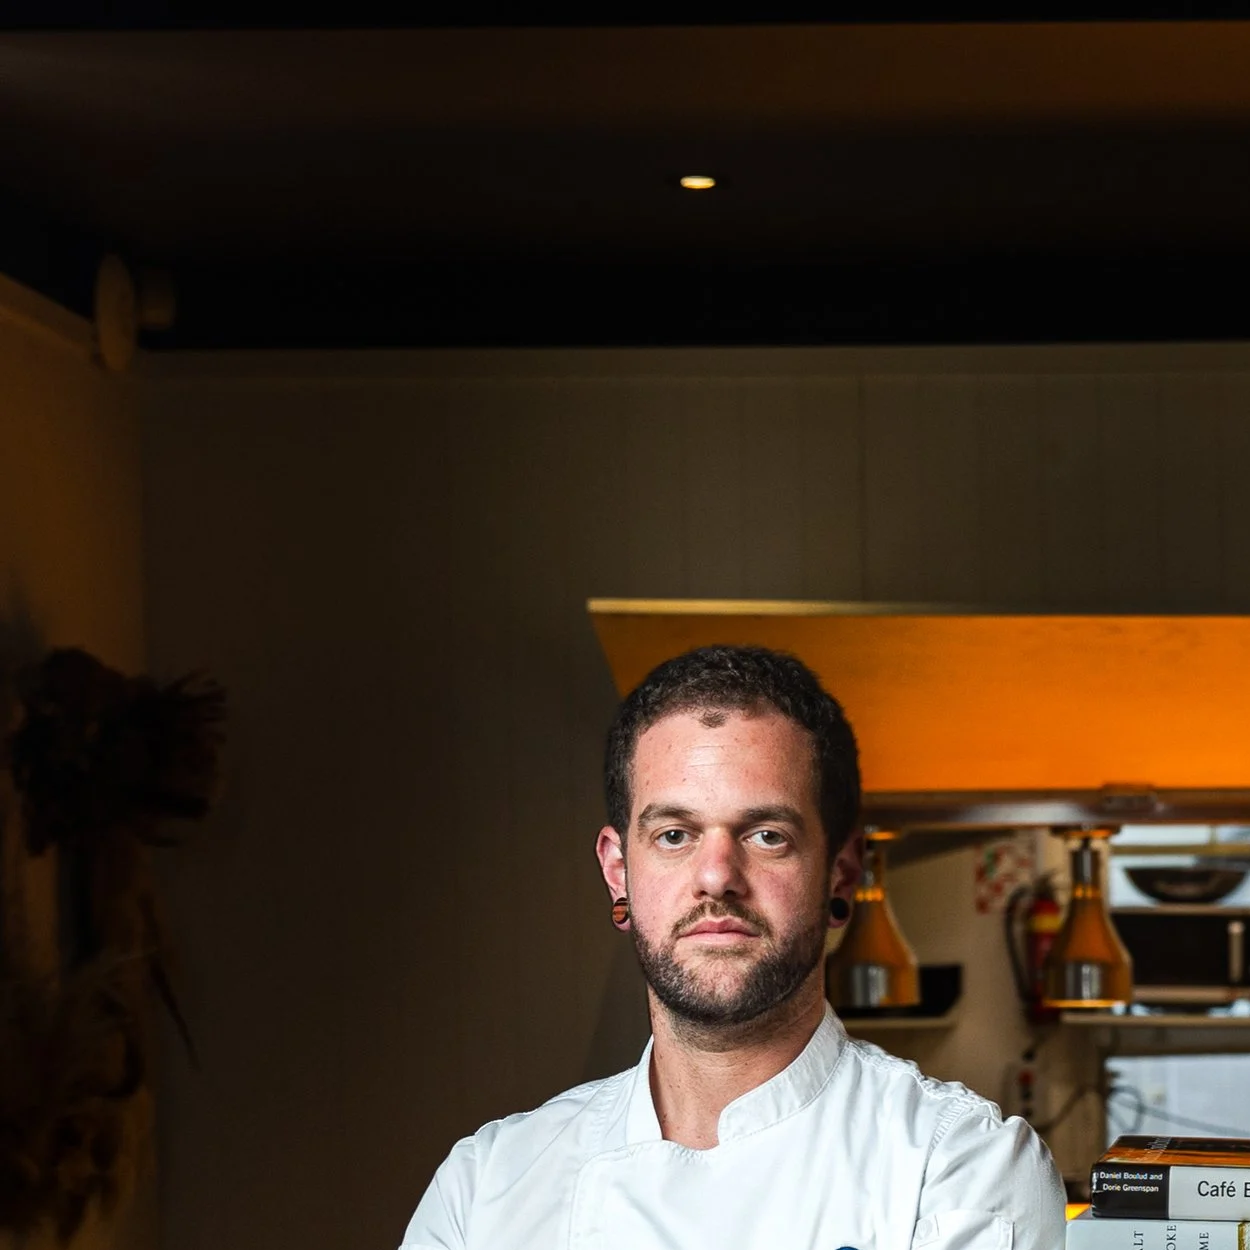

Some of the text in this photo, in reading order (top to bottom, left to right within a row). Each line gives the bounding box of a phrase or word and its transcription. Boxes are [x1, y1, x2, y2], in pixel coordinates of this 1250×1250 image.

[1100, 1172, 1122, 1180] Daniel
[1123, 1172, 1148, 1180] Boulud
[1123, 1184, 1159, 1193] Greenspan
[1198, 1180, 1236, 1198] Café
